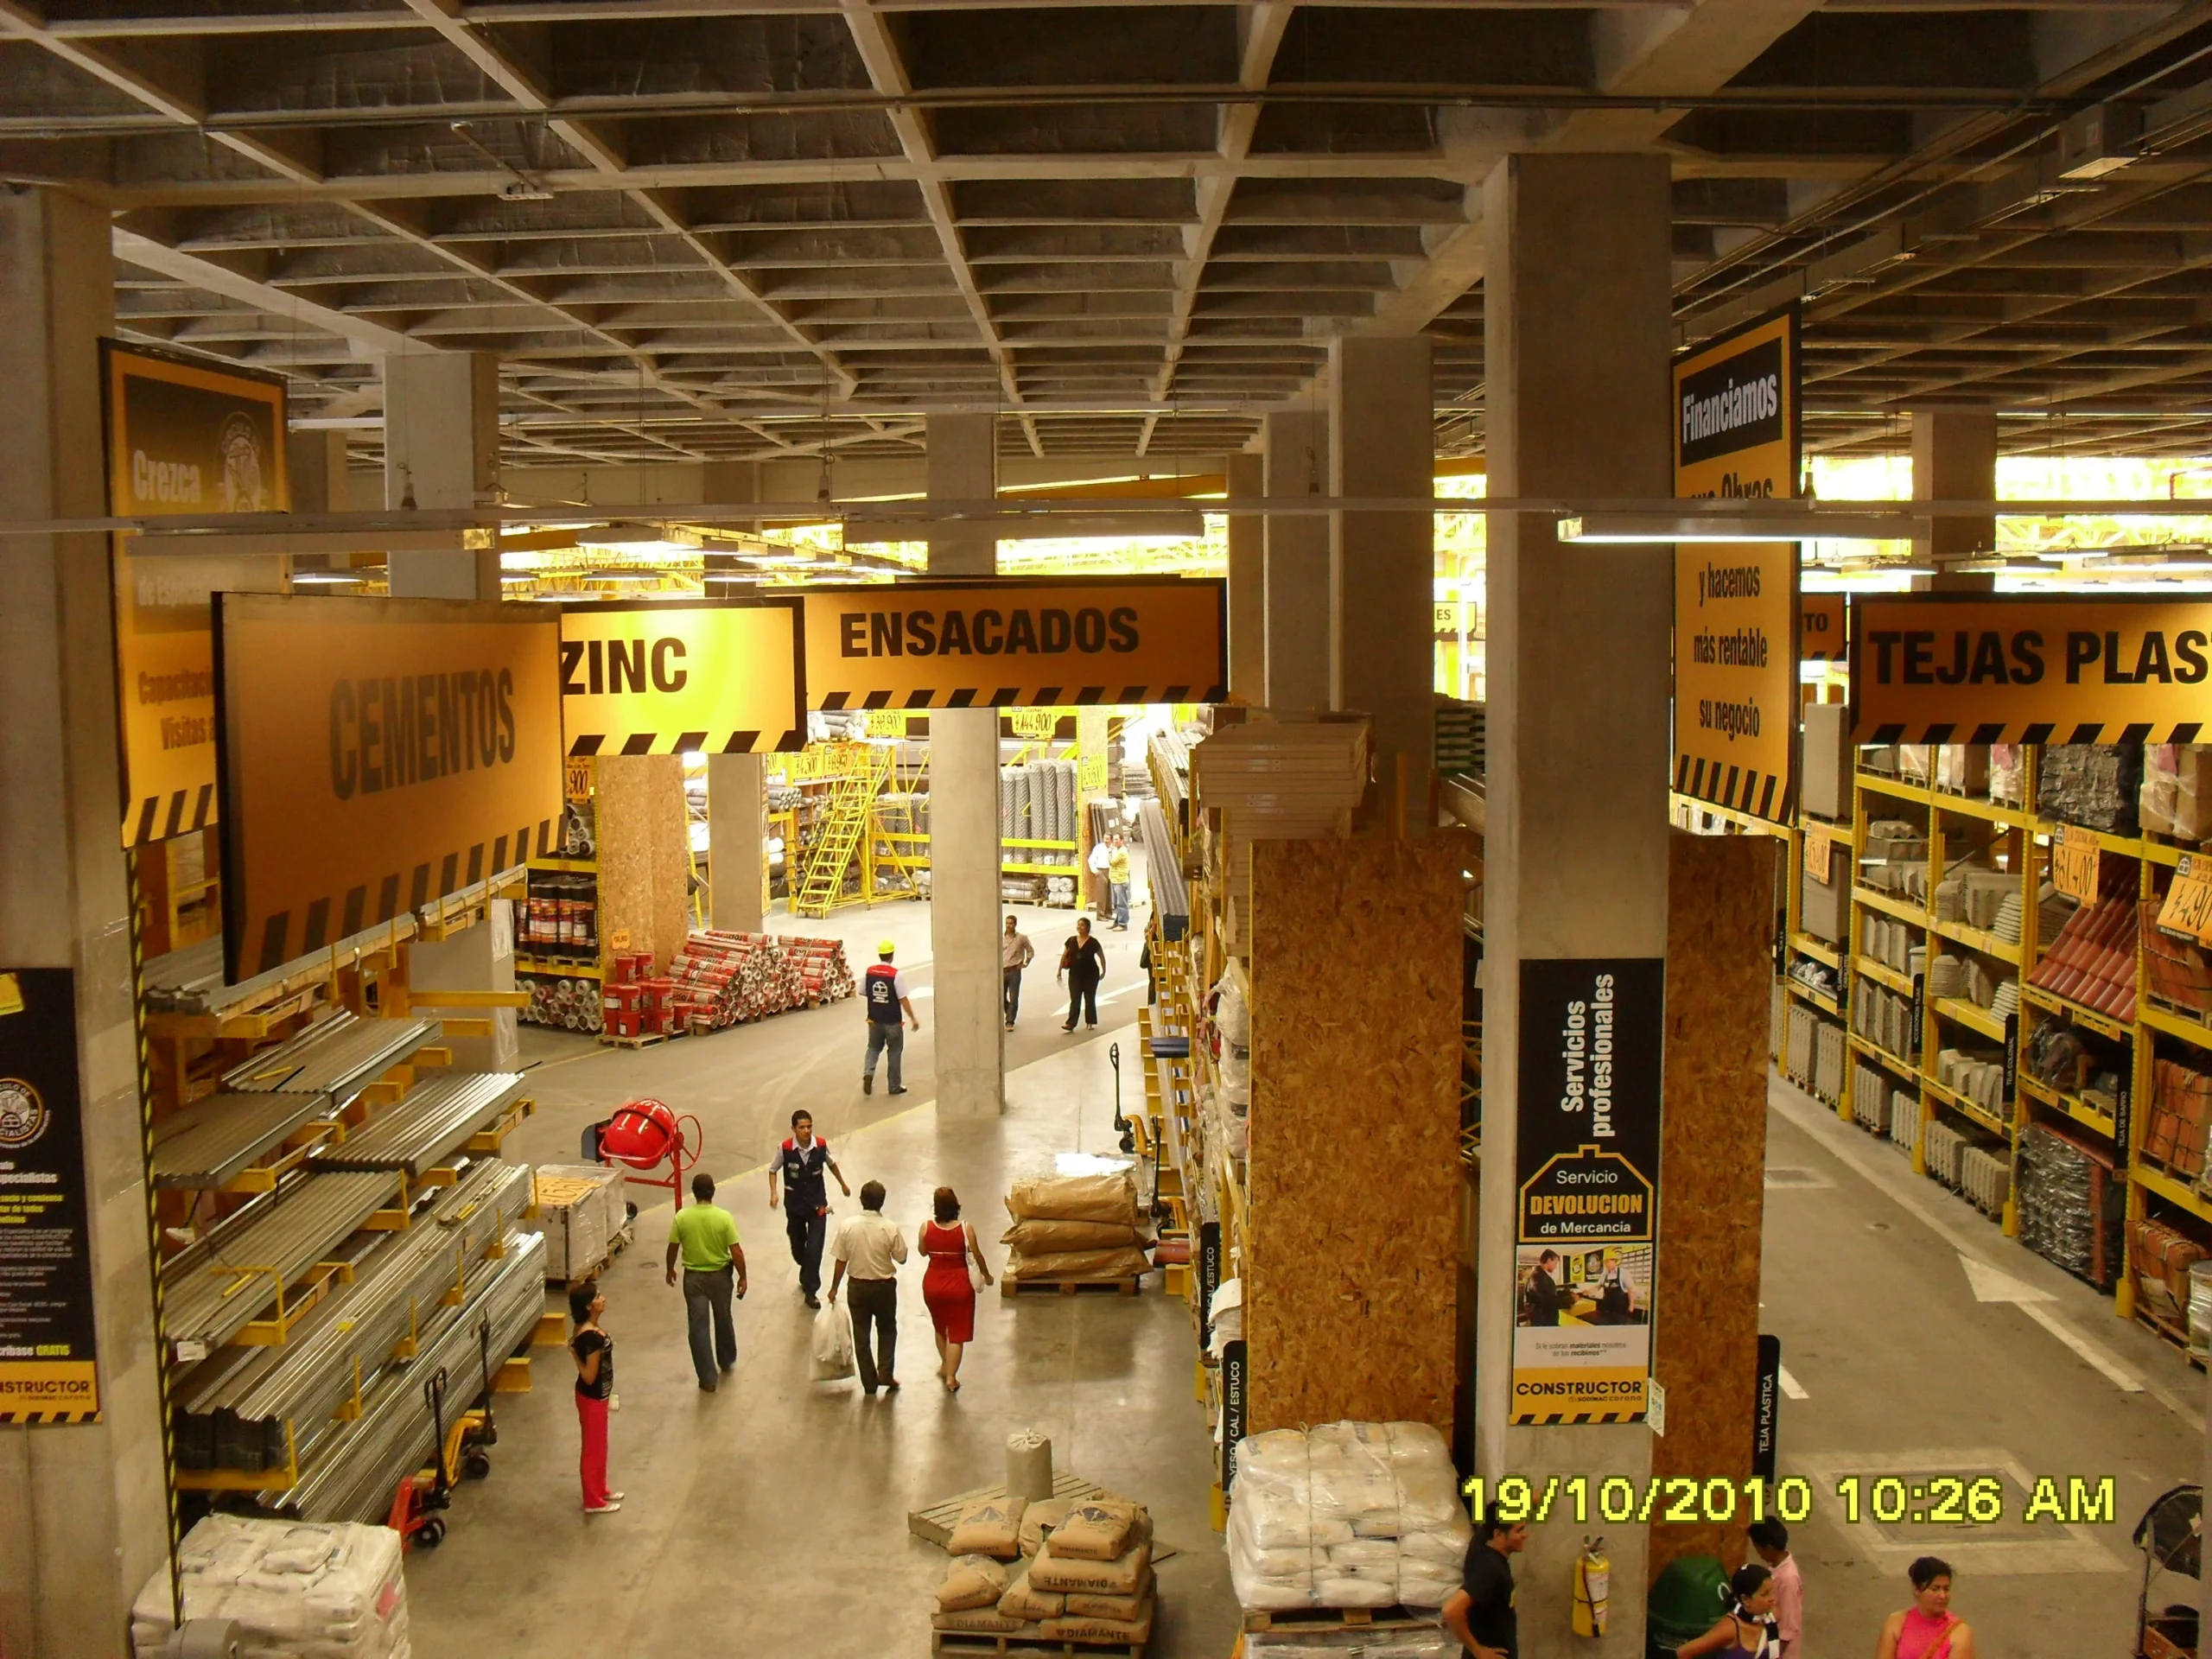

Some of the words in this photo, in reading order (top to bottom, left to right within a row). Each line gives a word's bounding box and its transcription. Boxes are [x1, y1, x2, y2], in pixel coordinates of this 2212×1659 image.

[1682, 373, 1777, 444] Financiamos
[133, 448, 200, 504] Crezca
[1699, 570, 1705, 607] y
[1707, 562, 1760, 598] hacemos
[840, 607, 1140, 658] ENSACADOS
[1694, 626, 1715, 664] más
[1719, 627, 1767, 668] rentable
[562, 637, 688, 696] ZINC
[1868, 629, 2044, 685] TEJAS
[2065, 629, 2212, 685] PLAS
[329, 667, 516, 801] CEMENTOS
[1699, 698, 1712, 728] su
[1715, 696, 1760, 741] negocio
[1560, 1000, 1586, 1112] Servicios
[1589, 974, 1615, 1137] profesionales
[2119, 1121, 2126, 1129] DE
[1556, 1170, 1618, 1185] Servicio
[1530, 1194, 1643, 1215] DEVOLUCION
[1540, 1223, 1557, 1234] de
[1560, 1221, 1631, 1234] Mercancia
[35, 1344, 71, 1357] GRATIS
[1230, 1361, 1241, 1406] ESTUCO
[1516, 1381, 1643, 1395] CONSTRUCTOR
[1761, 1374, 1773, 1425] PLASTICA
[1230, 1414, 1240, 1437] CAL
[1759, 1427, 1770, 1454] TEJA
[1044, 1576, 1109, 1588] DIAMANTE
[1067, 1629, 1131, 1641] DIAMANTE
